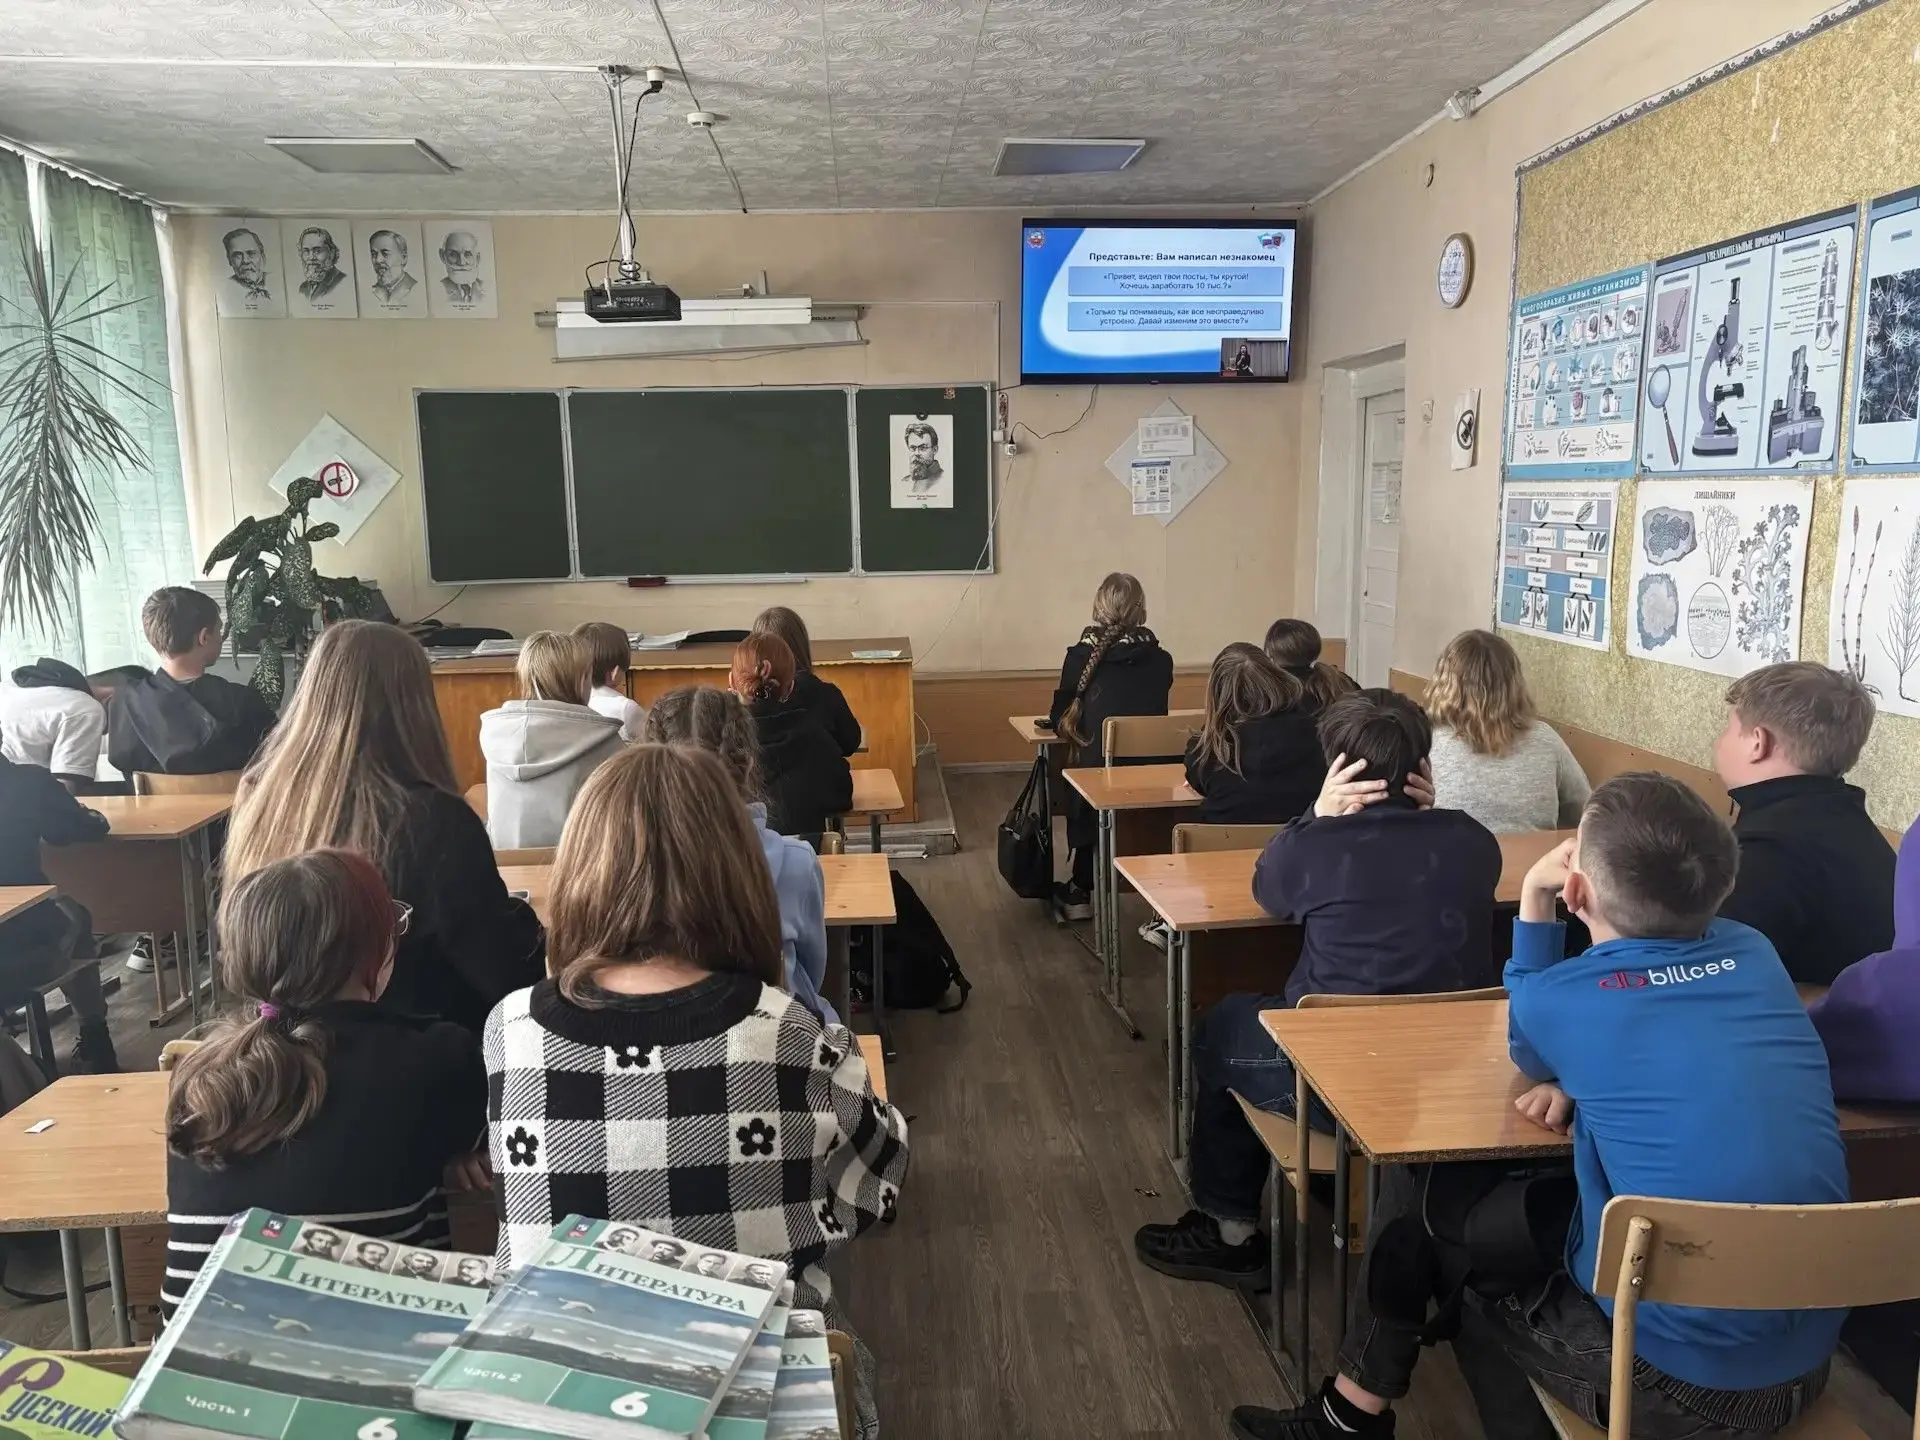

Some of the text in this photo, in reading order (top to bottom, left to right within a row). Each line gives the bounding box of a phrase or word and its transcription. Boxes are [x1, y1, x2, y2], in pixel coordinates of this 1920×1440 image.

[1706, 239, 1754, 262] УВЕЛИЧИТЕЛЬНЫЕ
[1089, 253, 1153, 262] Представьте:
[1156, 253, 1176, 261] Вам
[1219, 254, 1276, 262] незнакомец
[1221, 273, 1249, 281] крутой!
[1119, 282, 1150, 290] Хочешь
[1151, 282, 1194, 290] заработать
[1521, 296, 1566, 315] МНОГООБРАЗИЕ
[1567, 286, 1591, 302] ЖИВЫХ
[1592, 275, 1640, 295] ОРГАНИЗМОВ
[1206, 309, 1265, 317] несправедливо
[1138, 317, 1162, 325] Давай
[1693, 490, 1736, 500] ЛИШАЙНИКИ
[1647, 958, 1737, 986] billcee
[509, 1373, 522, 1383] 2
[610, 1391, 651, 1417] 6
[243, 1408, 251, 1417] 1
[357, 1416, 398, 1440] 6
